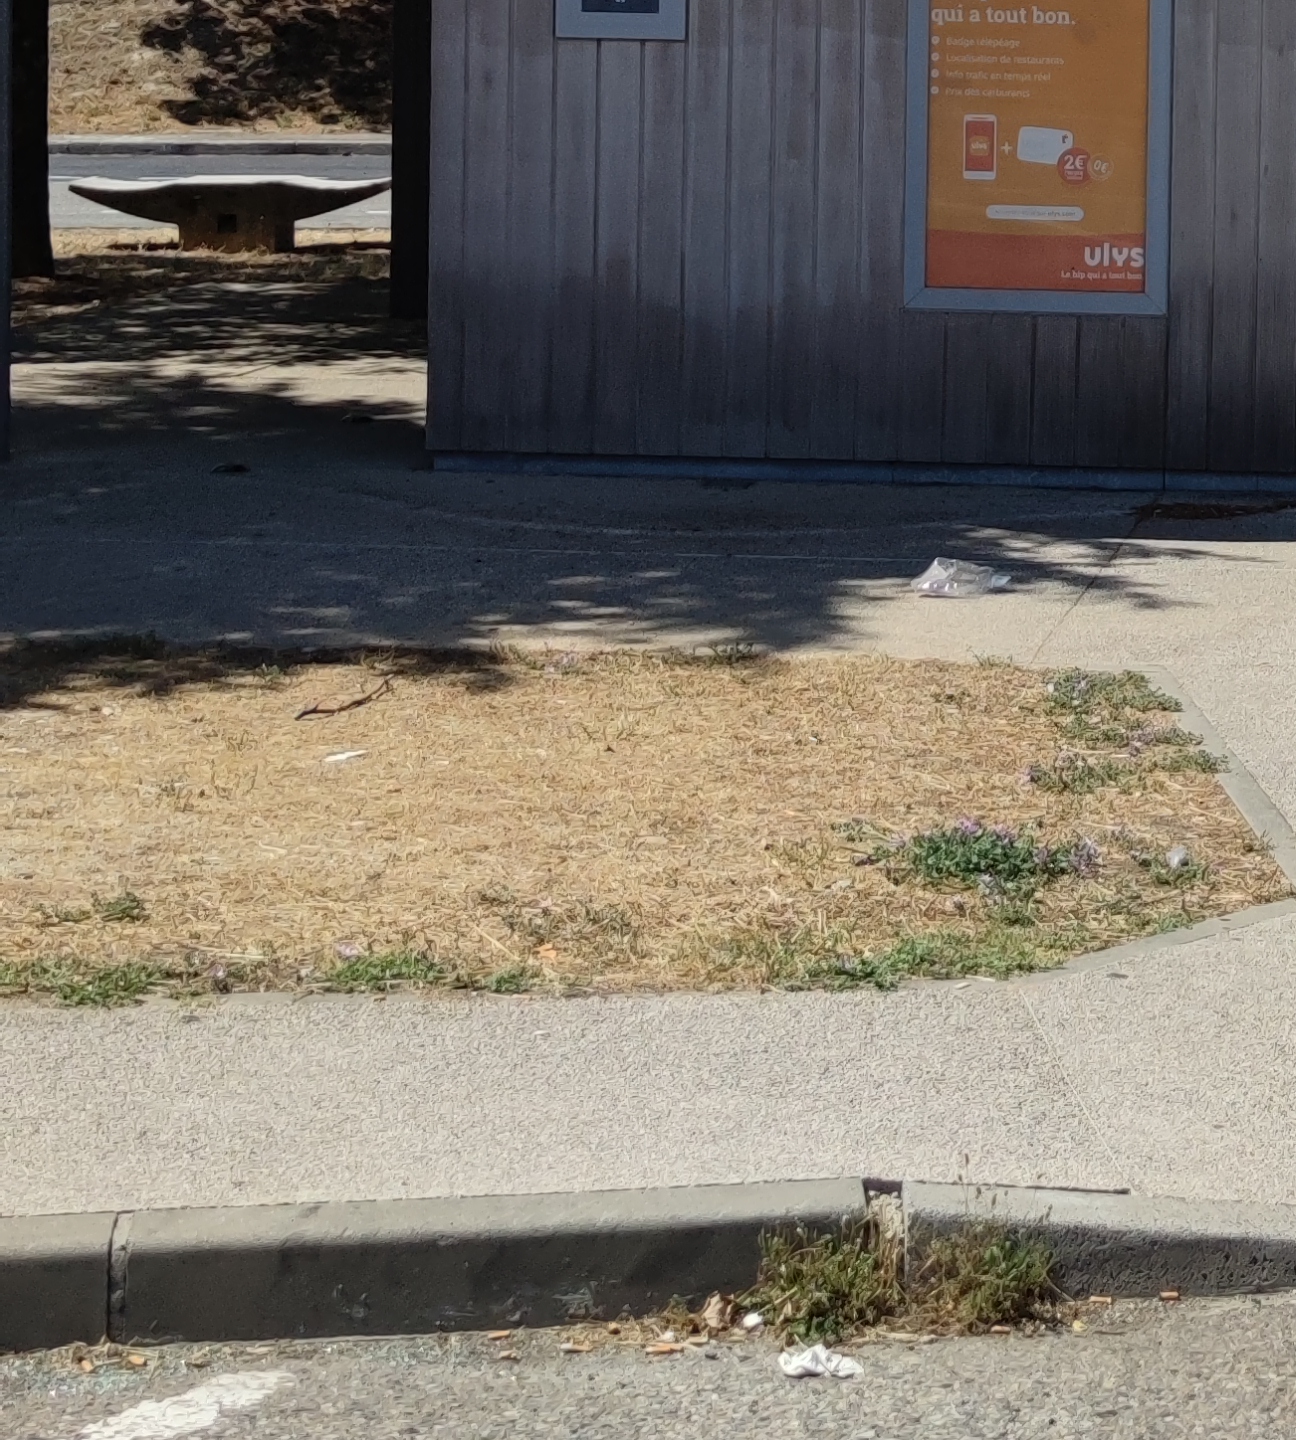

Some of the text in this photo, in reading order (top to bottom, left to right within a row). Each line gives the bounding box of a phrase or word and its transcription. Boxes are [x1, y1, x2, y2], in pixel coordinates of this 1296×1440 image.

[931, 4, 1076, 25] qui a tout bon.
[1000, 55, 1011, 64] de
[965, 88, 979, 96] des
[1064, 154, 1087, 170] 2€
[1084, 242, 1144, 267] ulys
[1061, 270, 1071, 278] Le
[1072, 270, 1085, 280] bip
[1087, 271, 1100, 280] qui
